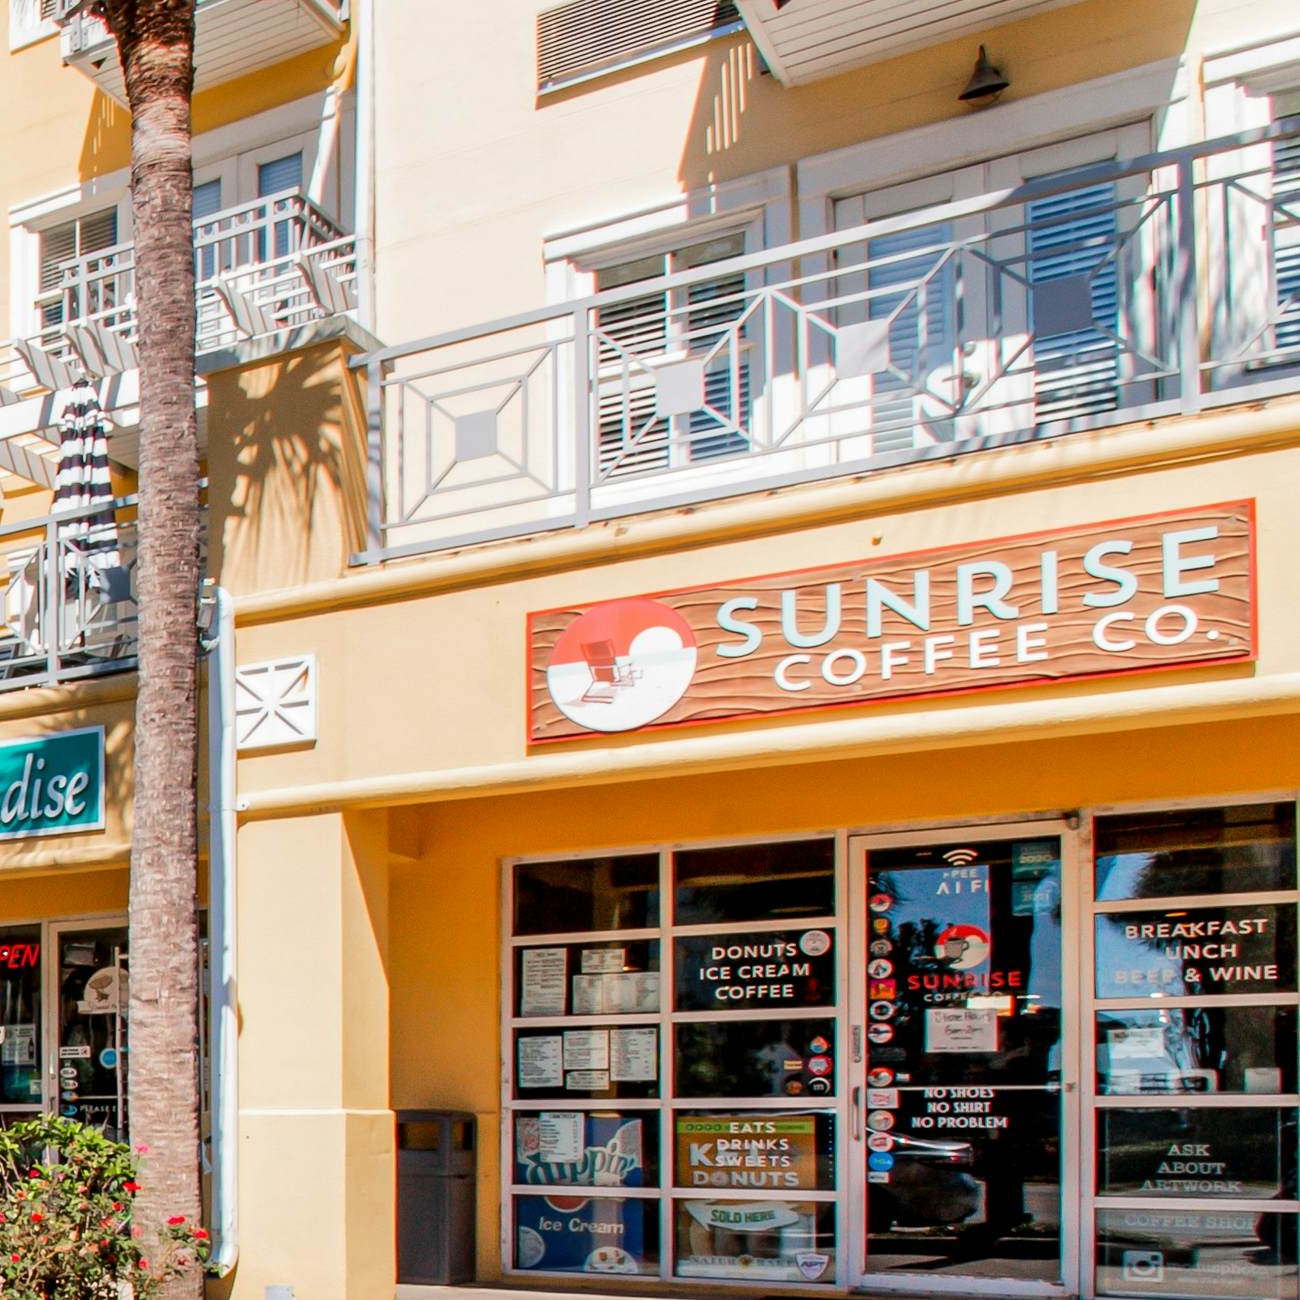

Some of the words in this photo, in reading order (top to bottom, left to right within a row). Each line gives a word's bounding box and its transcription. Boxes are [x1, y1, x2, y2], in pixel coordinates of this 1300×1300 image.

[715, 525, 1221, 659] SUNRISE
[773, 622, 1049, 693] COFFEE
[1090, 603, 1221, 653] CO.
[943, 867, 979, 879] REE
[1124, 918, 1269, 940] BREAKFAST
[711, 943, 797, 961] DONUTS
[1155, 943, 1238, 961] UNCH
[699, 966, 731, 981] ICE
[737, 963, 811, 980] CREAM
[1183, 967, 1201, 983] &
[1209, 964, 1279, 982] WINE
[906, 971, 1022, 990] SUNRISE
[715, 983, 794, 1000] COFFEE
[924, 1087, 947, 1099] NO
[950, 1087, 996, 1099] SHOES
[927, 1101, 950, 1114] NO
[953, 1101, 992, 1114] SHIRT
[729, 1121, 777, 1134] EATS
[911, 1116, 935, 1129] NO
[937, 1116, 1009, 1129] PROBLEM
[716, 1138, 790, 1151] DRINKS
[1166, 1144, 1211, 1157] ASK
[714, 1155, 791, 1168] SWEETS
[1156, 1162, 1226, 1175] ABOUT
[692, 1170, 800, 1187] DONUTS
[1139, 1180, 1243, 1193] ARTWORK
[710, 1208, 743, 1224] SOLD
[744, 1208, 777, 1223] HERE
[1124, 1213, 1200, 1228] COFFEE
[538, 1216, 563, 1232] Ice
[568, 1217, 625, 1234] Cream
